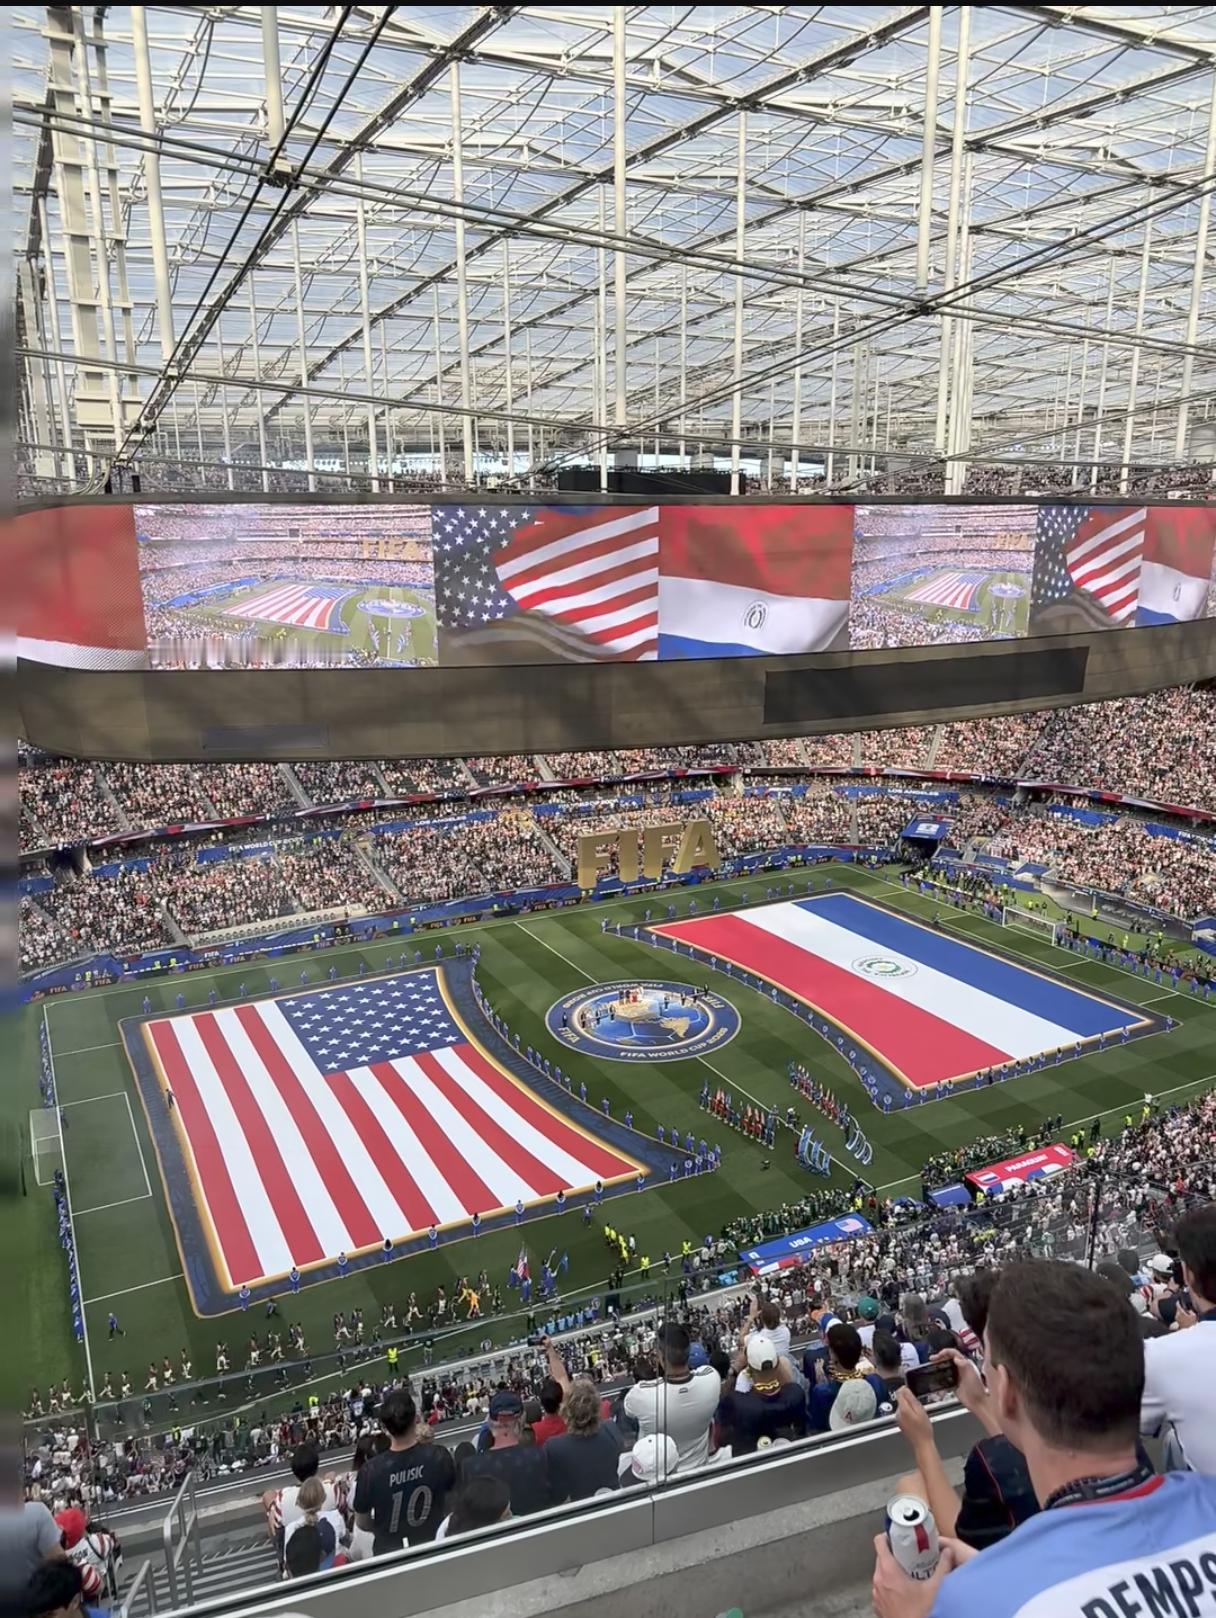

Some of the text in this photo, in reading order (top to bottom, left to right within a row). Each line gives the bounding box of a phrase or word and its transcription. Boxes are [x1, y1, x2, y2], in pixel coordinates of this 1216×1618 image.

[577, 819, 721, 889] FIFA
[204, 950, 220, 959] FIFA
[558, 1026, 580, 1044] FIFA
[620, 1050, 647, 1058] FIFA
[648, 1047, 689, 1058] WORLD
[688, 1041, 707, 1052] CUP
[788, 1236, 813, 1249] USA
[389, 1464, 424, 1488] PULISIC
[388, 1484, 433, 1534] 10
